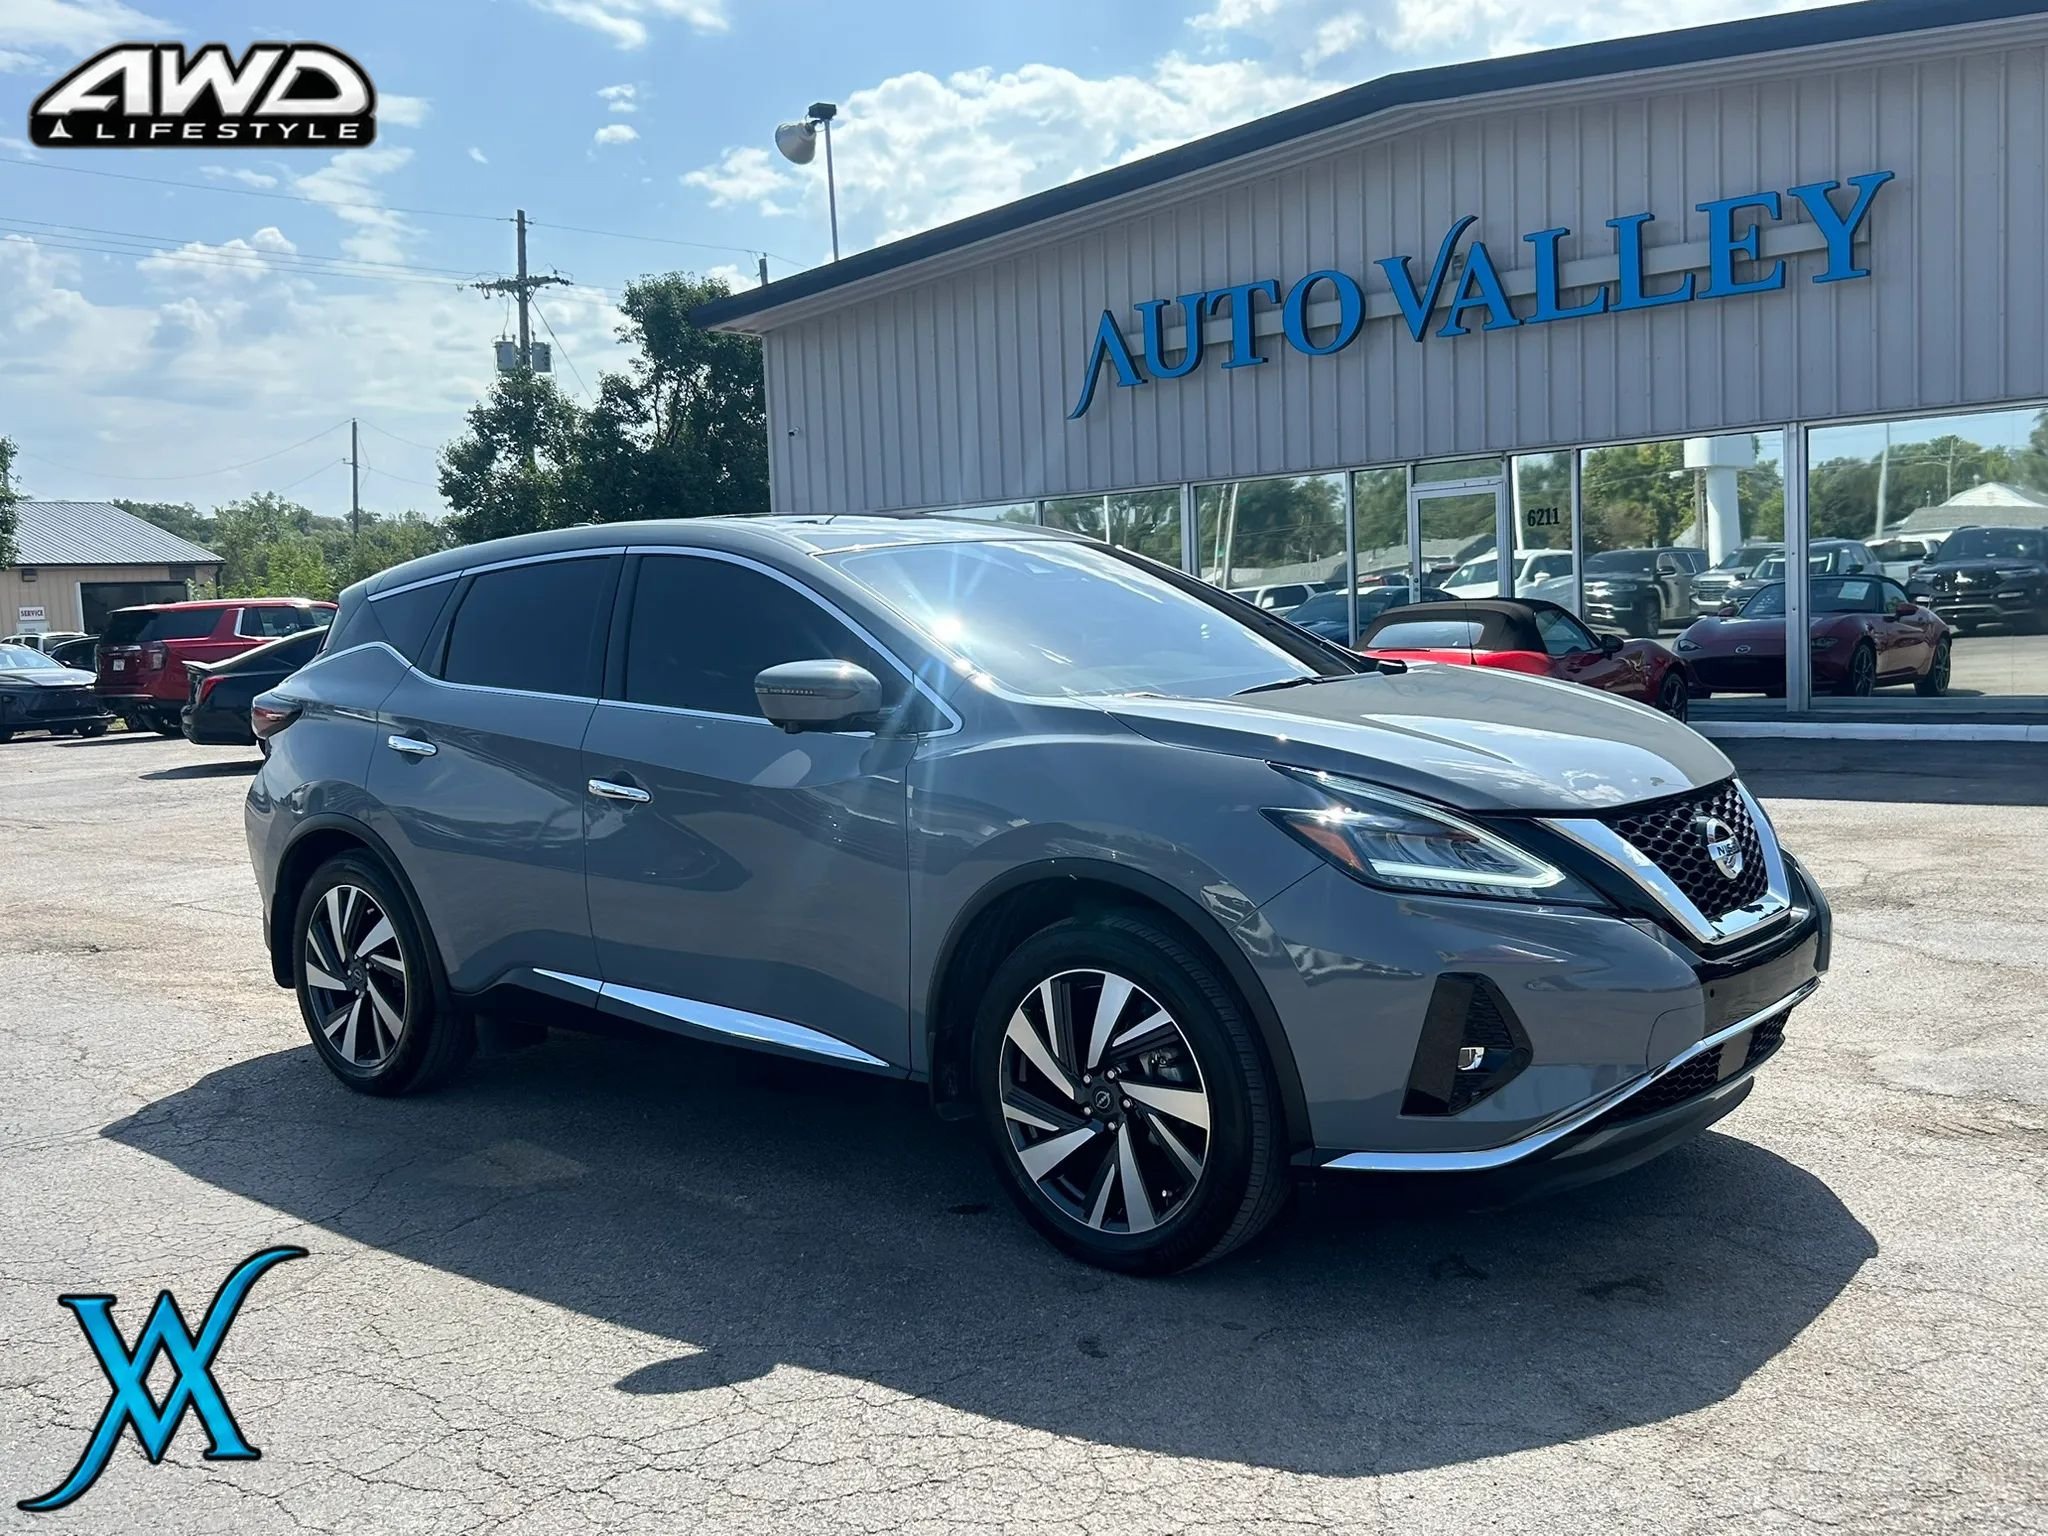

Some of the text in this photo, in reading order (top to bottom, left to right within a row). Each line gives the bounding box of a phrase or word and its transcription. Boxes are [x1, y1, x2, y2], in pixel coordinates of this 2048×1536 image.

[1066, 170, 1896, 420] AUTO VALLEY
[1527, 507, 1560, 527] 6211
[20, 609, 44, 617] SERVICE
